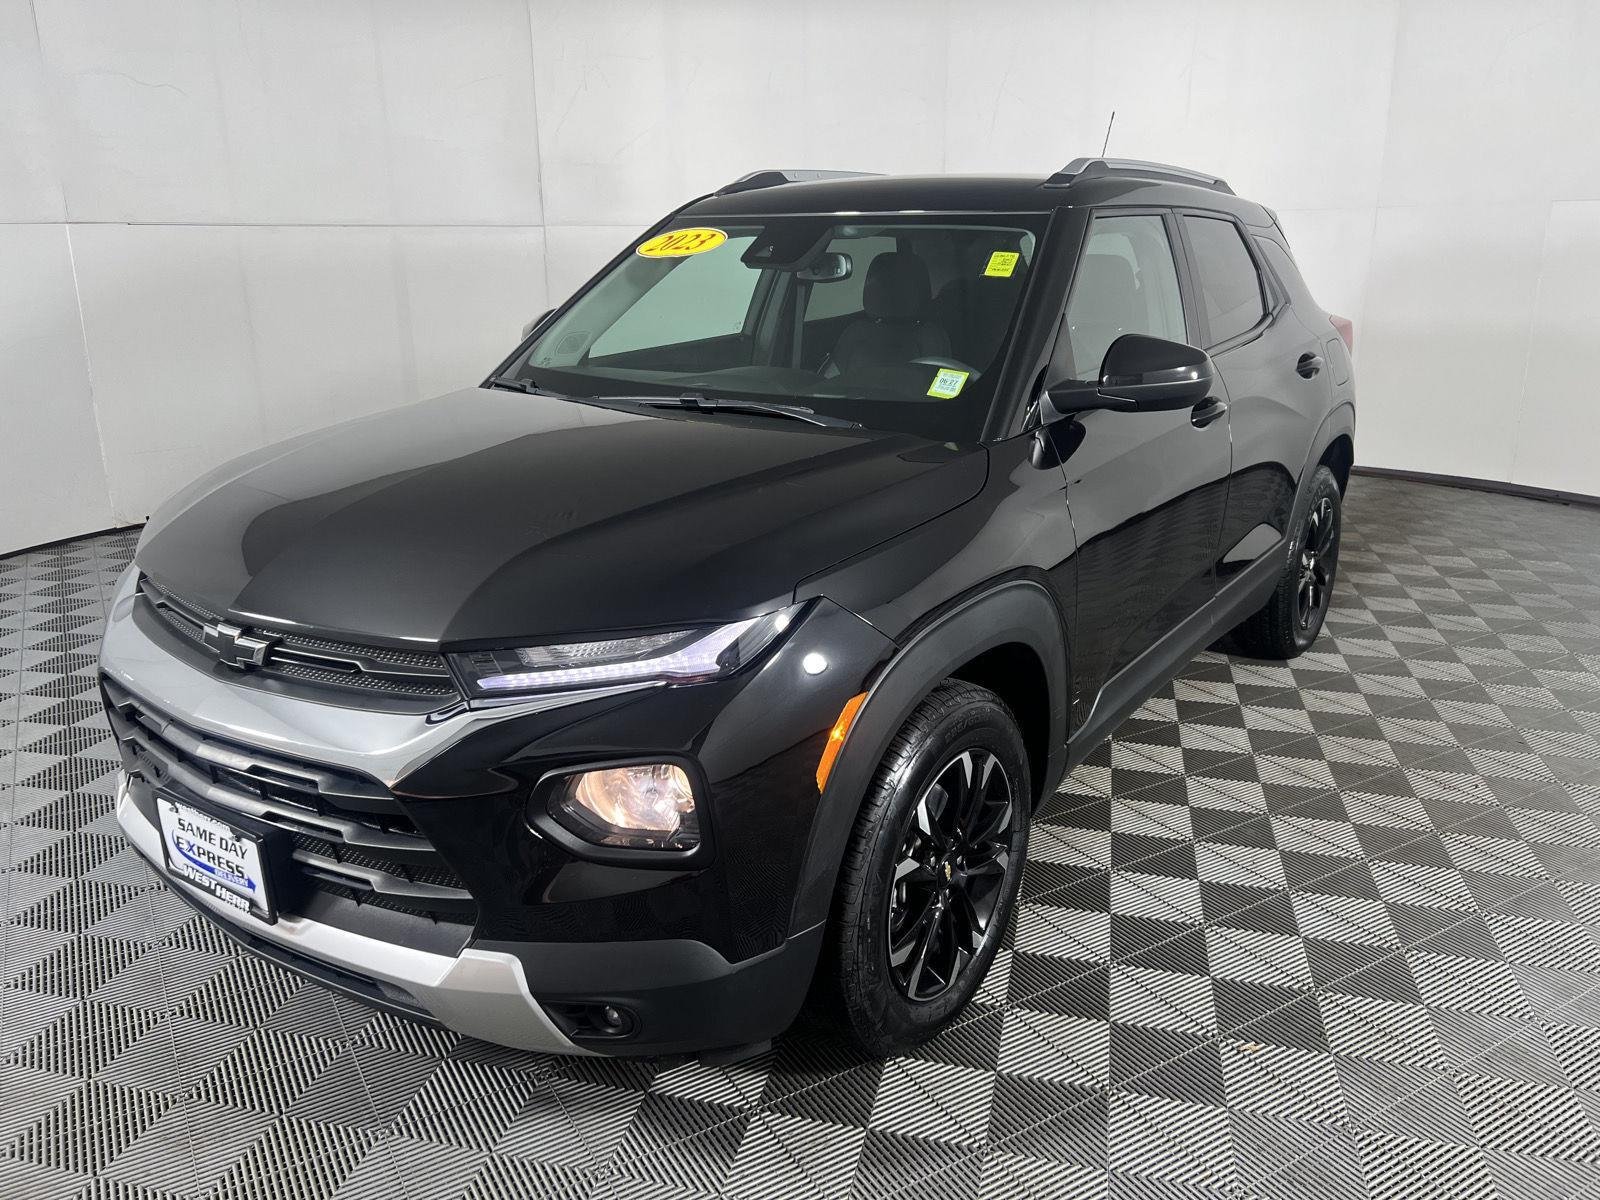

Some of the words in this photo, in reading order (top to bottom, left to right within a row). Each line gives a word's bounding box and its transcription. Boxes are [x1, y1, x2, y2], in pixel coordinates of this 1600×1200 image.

[645, 233, 716, 252] 2023
[176, 835, 246, 879] EXPRESS
[178, 818, 216, 846] SAME
[220, 837, 248, 860] DAY
[182, 863, 217, 890] WEST
[215, 885, 250, 912] HERR
